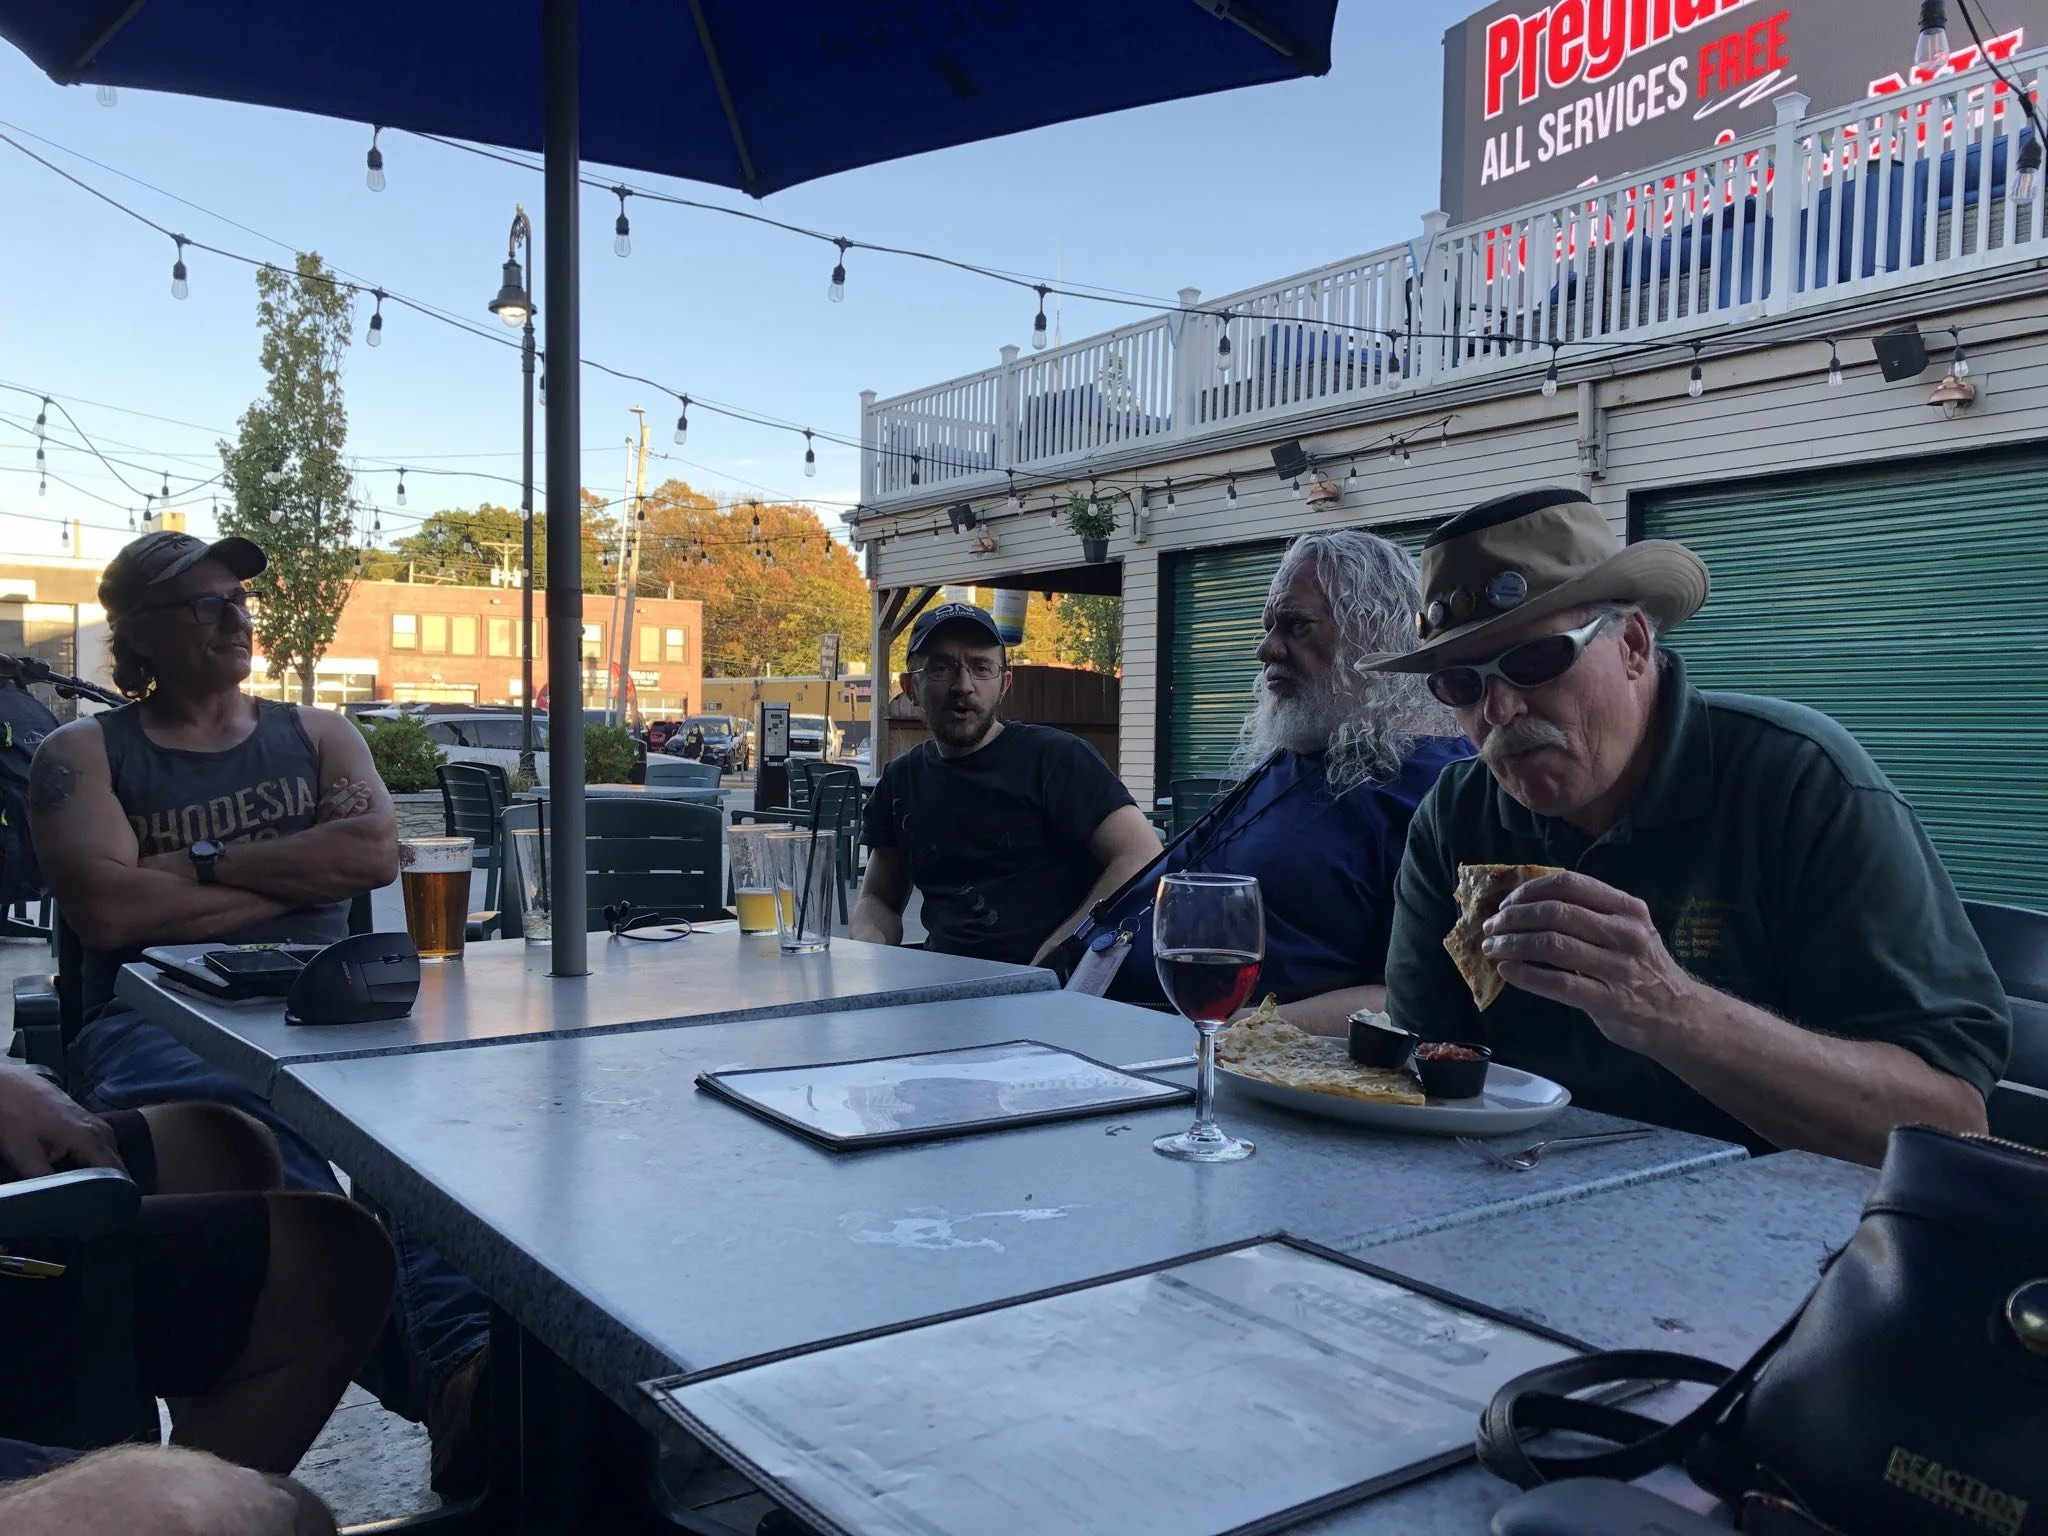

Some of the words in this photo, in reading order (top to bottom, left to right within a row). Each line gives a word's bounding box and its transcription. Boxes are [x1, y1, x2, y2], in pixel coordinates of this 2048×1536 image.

[1480, 125, 1531, 187] ALL
[1537, 55, 1689, 163] SERVICES
[1697, 9, 1791, 100] FREE
[1883, 1446, 2029, 1535] REACTION
